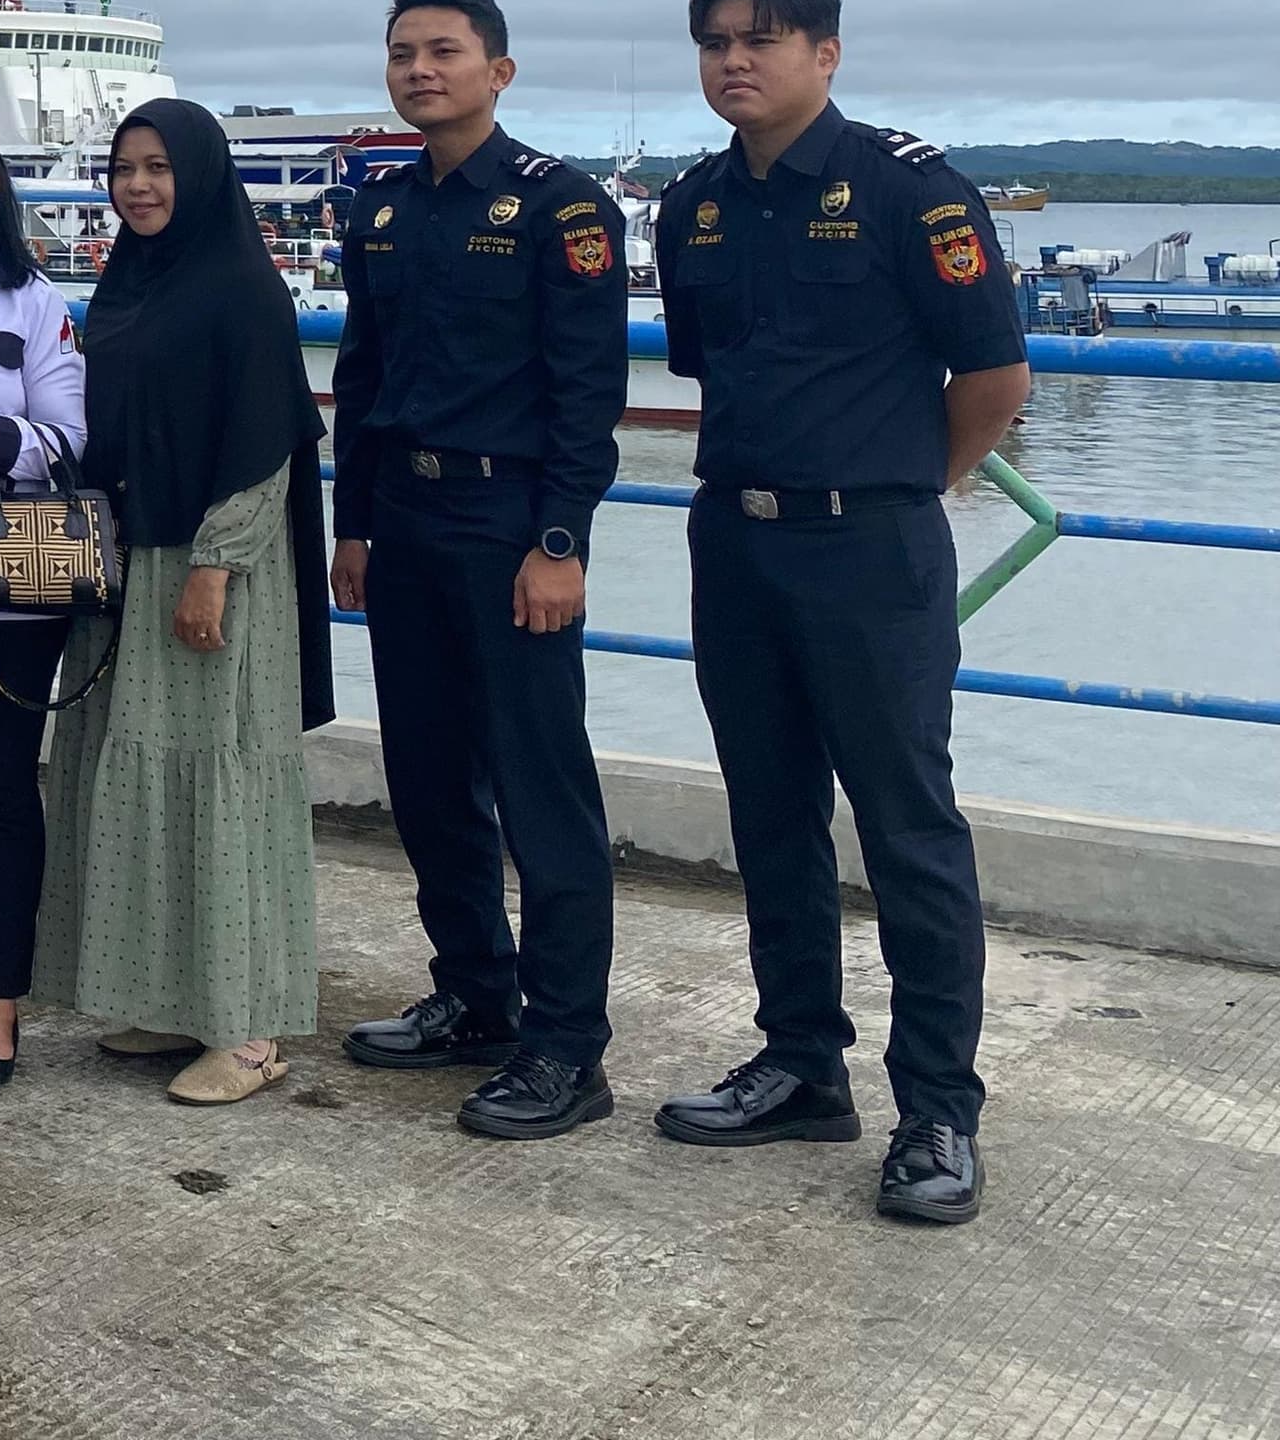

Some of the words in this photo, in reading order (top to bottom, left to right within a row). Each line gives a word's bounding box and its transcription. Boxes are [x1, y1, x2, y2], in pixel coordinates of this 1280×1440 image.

[809, 221, 859, 230] CUSTOMS
[808, 230, 857, 239] EXCISE
[469, 235, 516, 246] CUSTOMS
[467, 244, 514, 255] EXCISE
